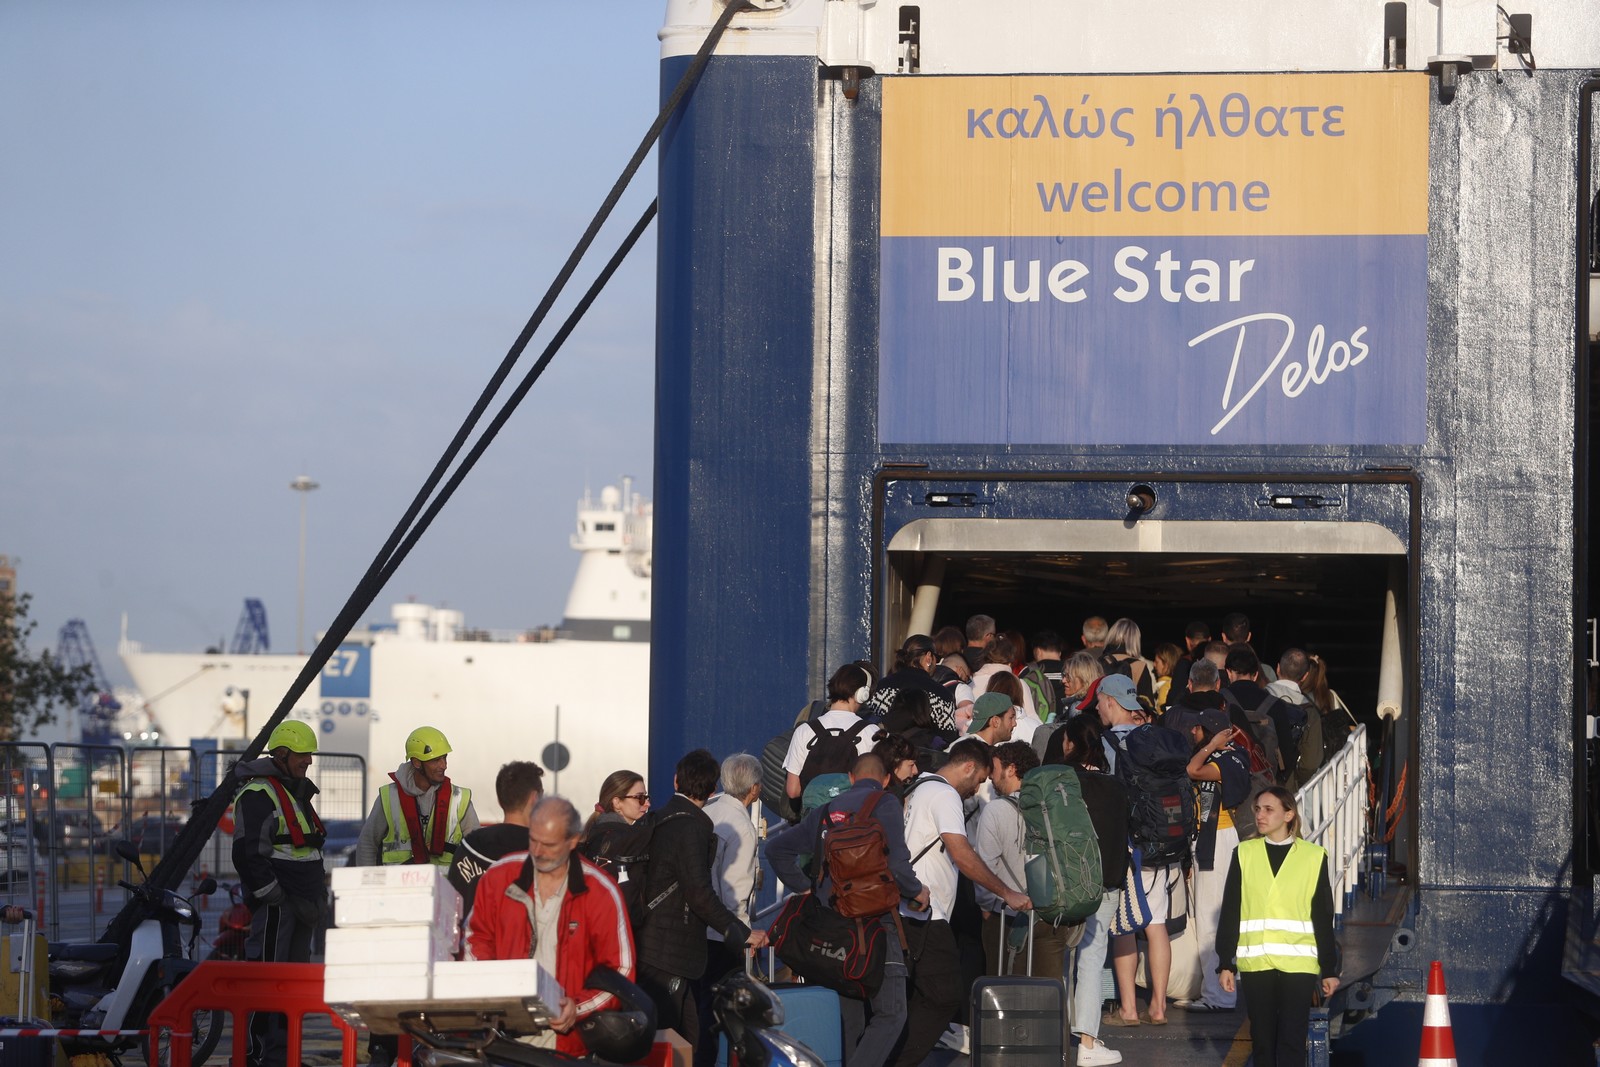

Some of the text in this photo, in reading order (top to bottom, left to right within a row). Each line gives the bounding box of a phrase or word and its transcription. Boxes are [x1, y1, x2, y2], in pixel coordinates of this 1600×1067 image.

[967, 93, 1345, 149] καλώς ήλθατε
[1037, 168, 1270, 213] welcome
[937, 246, 1255, 303] Blue Star
[1188, 312, 1369, 435] Delos
